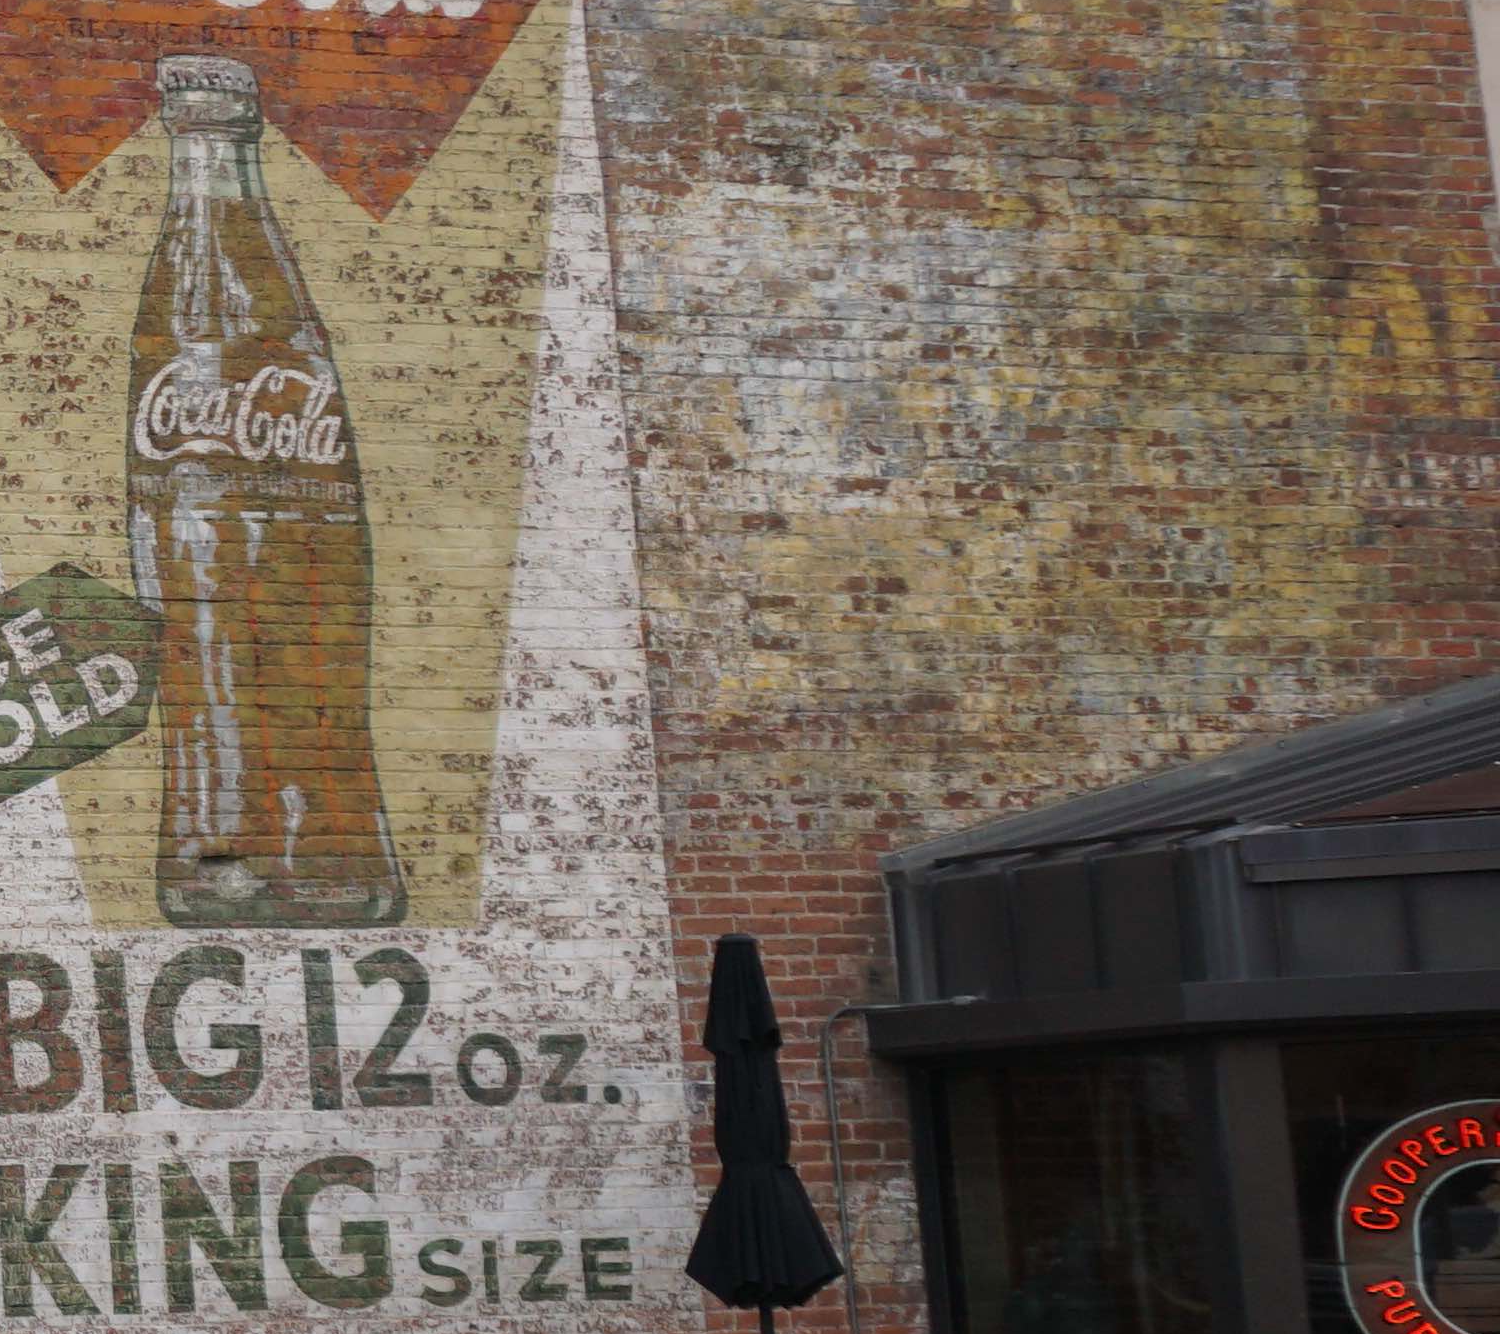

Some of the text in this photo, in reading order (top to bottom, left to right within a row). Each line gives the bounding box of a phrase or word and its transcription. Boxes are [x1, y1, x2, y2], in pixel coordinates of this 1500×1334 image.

[300, 945, 435, 1111] 12
[1349, 1117, 1500, 1232] COOPER
[416, 1235, 634, 1309] SIZE
